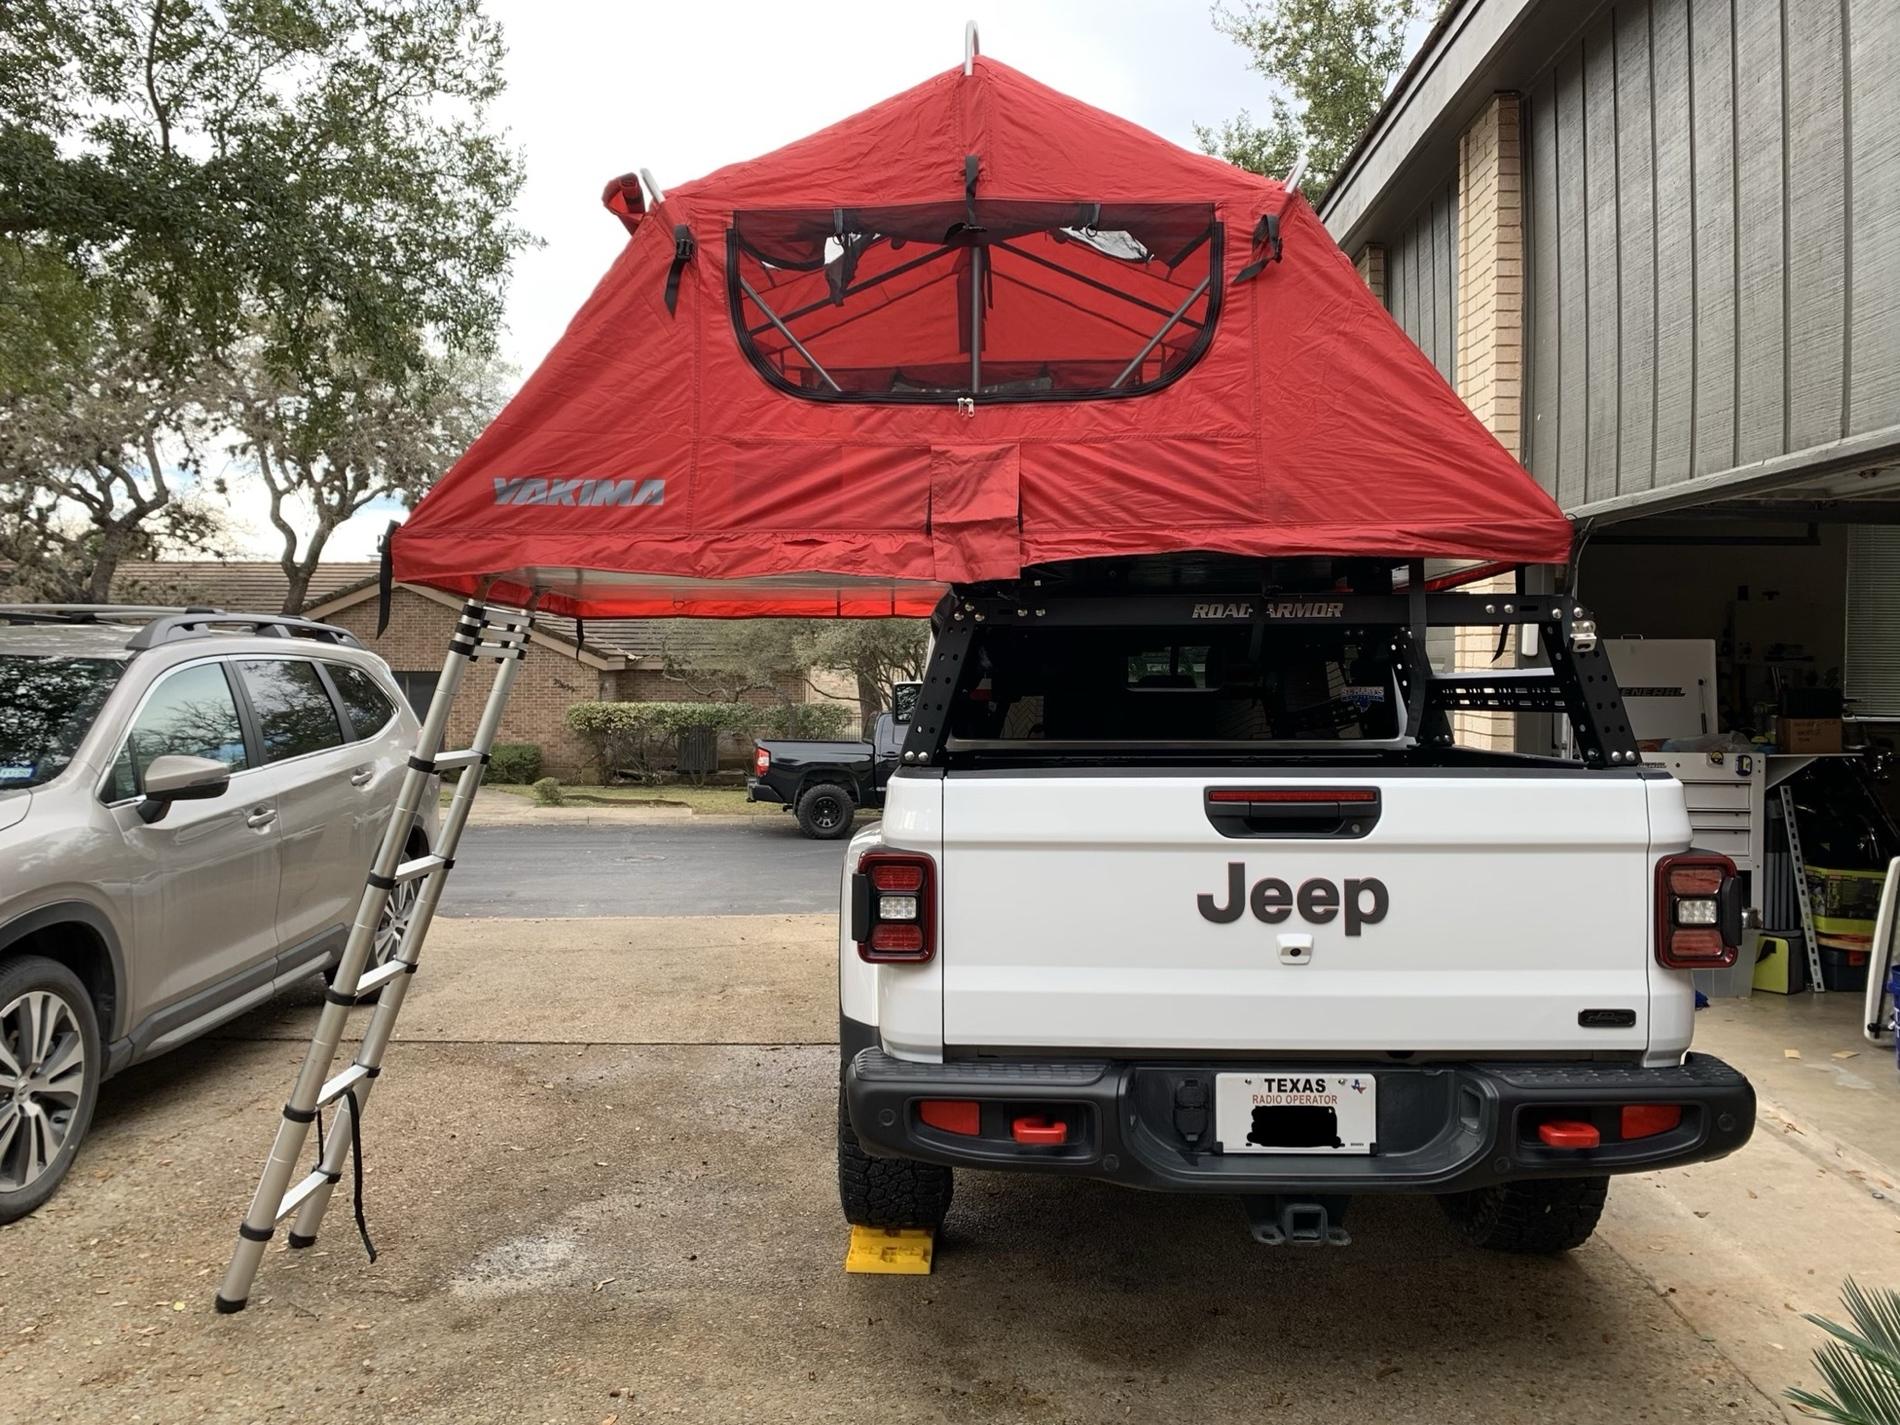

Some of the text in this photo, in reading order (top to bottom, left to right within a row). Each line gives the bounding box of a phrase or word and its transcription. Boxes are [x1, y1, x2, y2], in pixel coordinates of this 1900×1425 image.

[494, 478, 666, 506] YAKIMA
[1620, 687, 1686, 697] ENERAL
[1197, 862, 1389, 936] Jeep
[1264, 1078, 1326, 1093] TEXAS
[1252, 1094, 1338, 1105] RADIO OPERATOR
